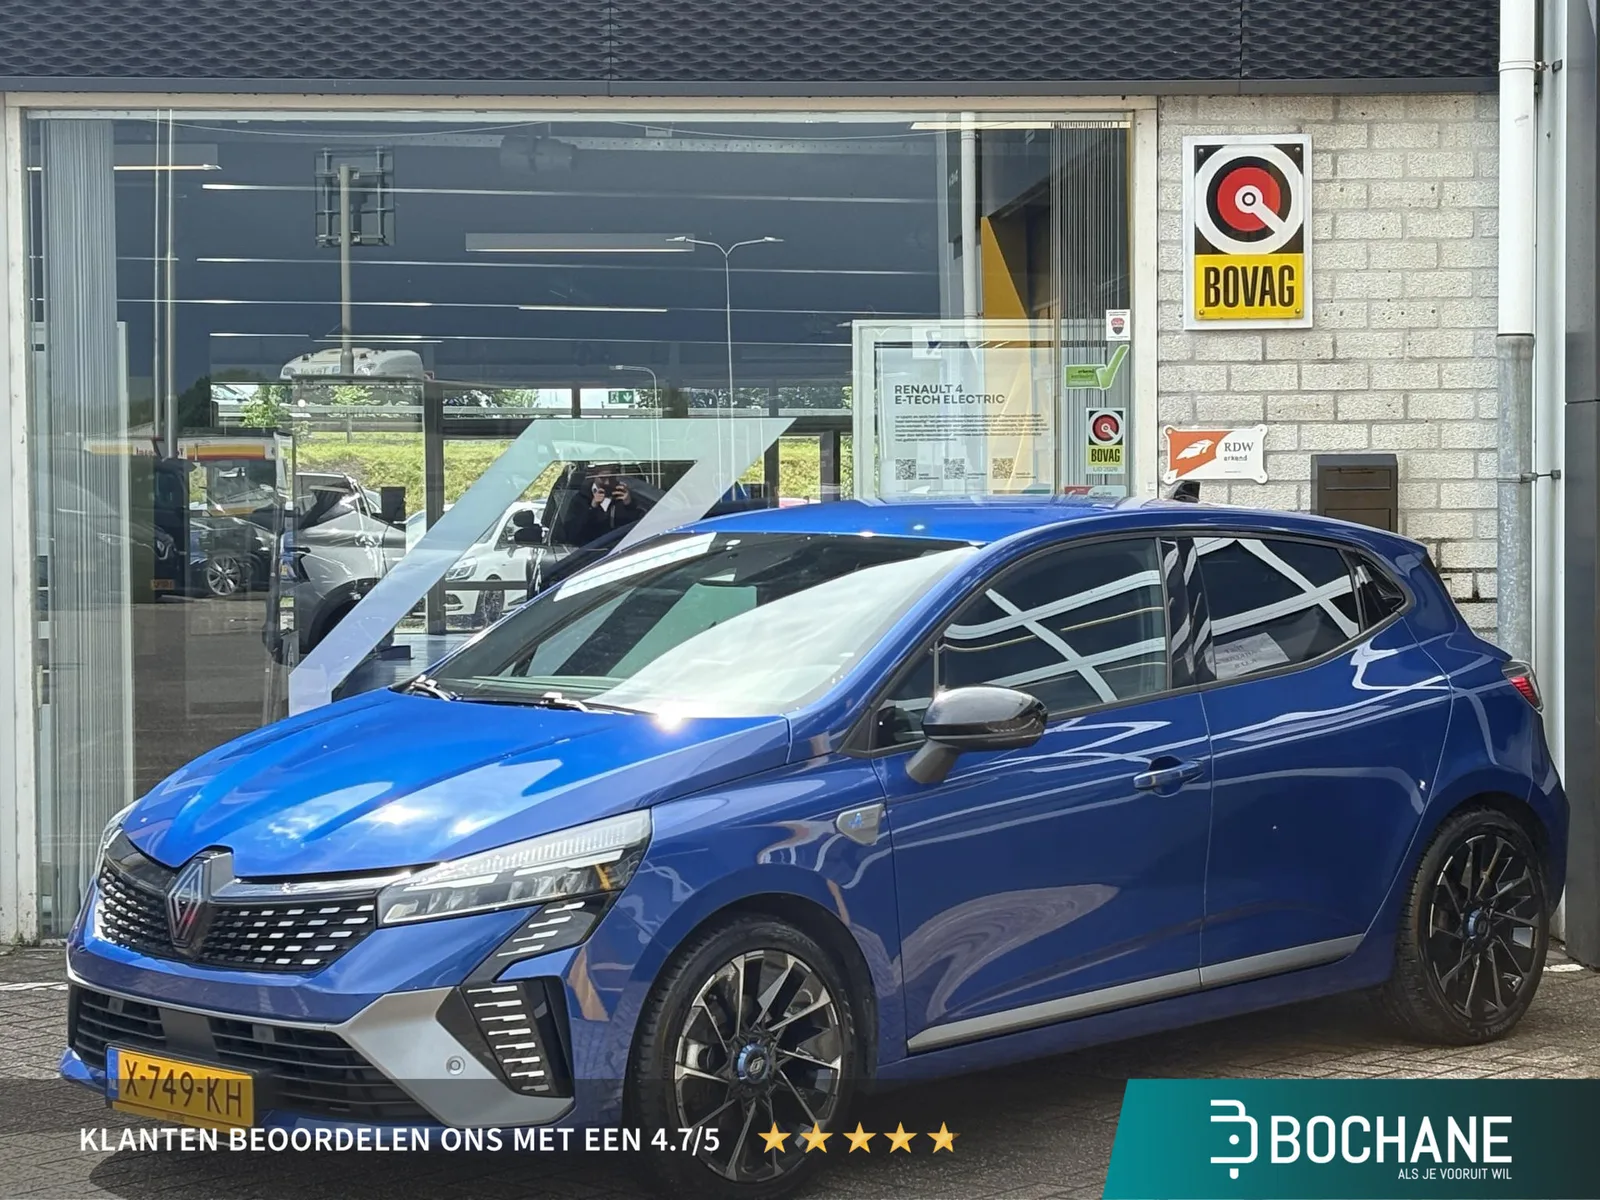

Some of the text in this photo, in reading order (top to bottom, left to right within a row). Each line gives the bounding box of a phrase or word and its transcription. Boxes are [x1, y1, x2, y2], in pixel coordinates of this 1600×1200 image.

[1204, 265, 1295, 308] BOVAG
[895, 384, 963, 394] RENAULT 4
[895, 394, 1005, 405] E-TECH ELECTRIC
[1224, 442, 1254, 452] RDW
[1091, 448, 1121, 463] BOVAG
[124, 1059, 243, 1118] X-749-KH
